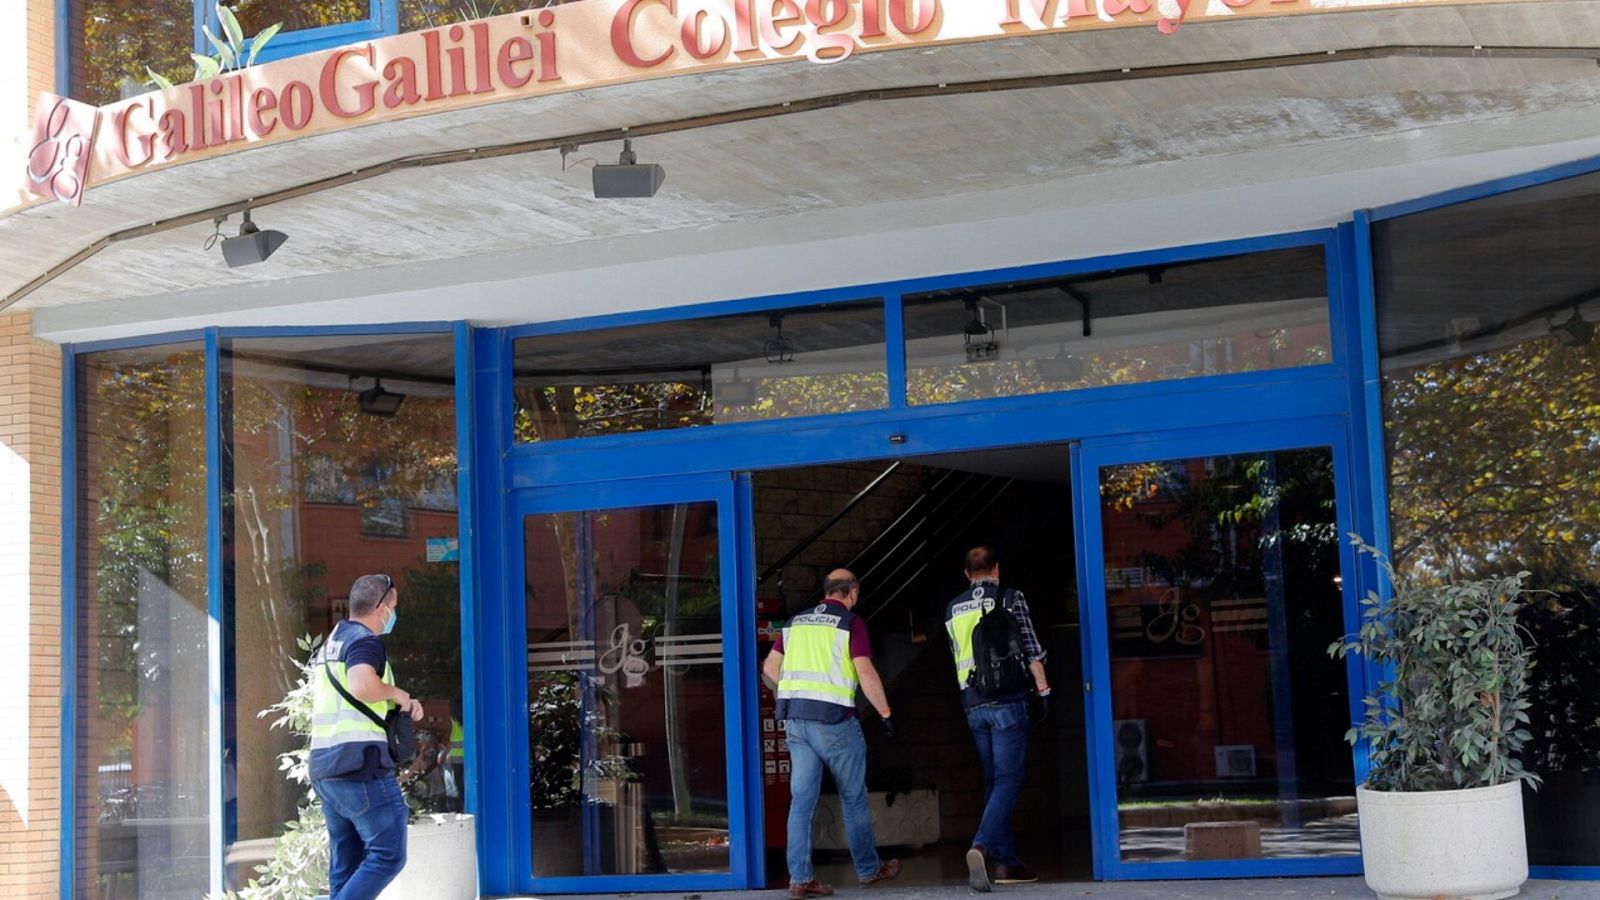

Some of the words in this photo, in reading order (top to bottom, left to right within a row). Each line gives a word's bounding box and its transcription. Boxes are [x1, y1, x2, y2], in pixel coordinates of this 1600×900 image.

[114, 76, 313, 168] Galileo
[319, 9, 562, 118] Galilei
[952, 599, 994, 615] POLICI
[793, 616, 837, 626] POLICIA
